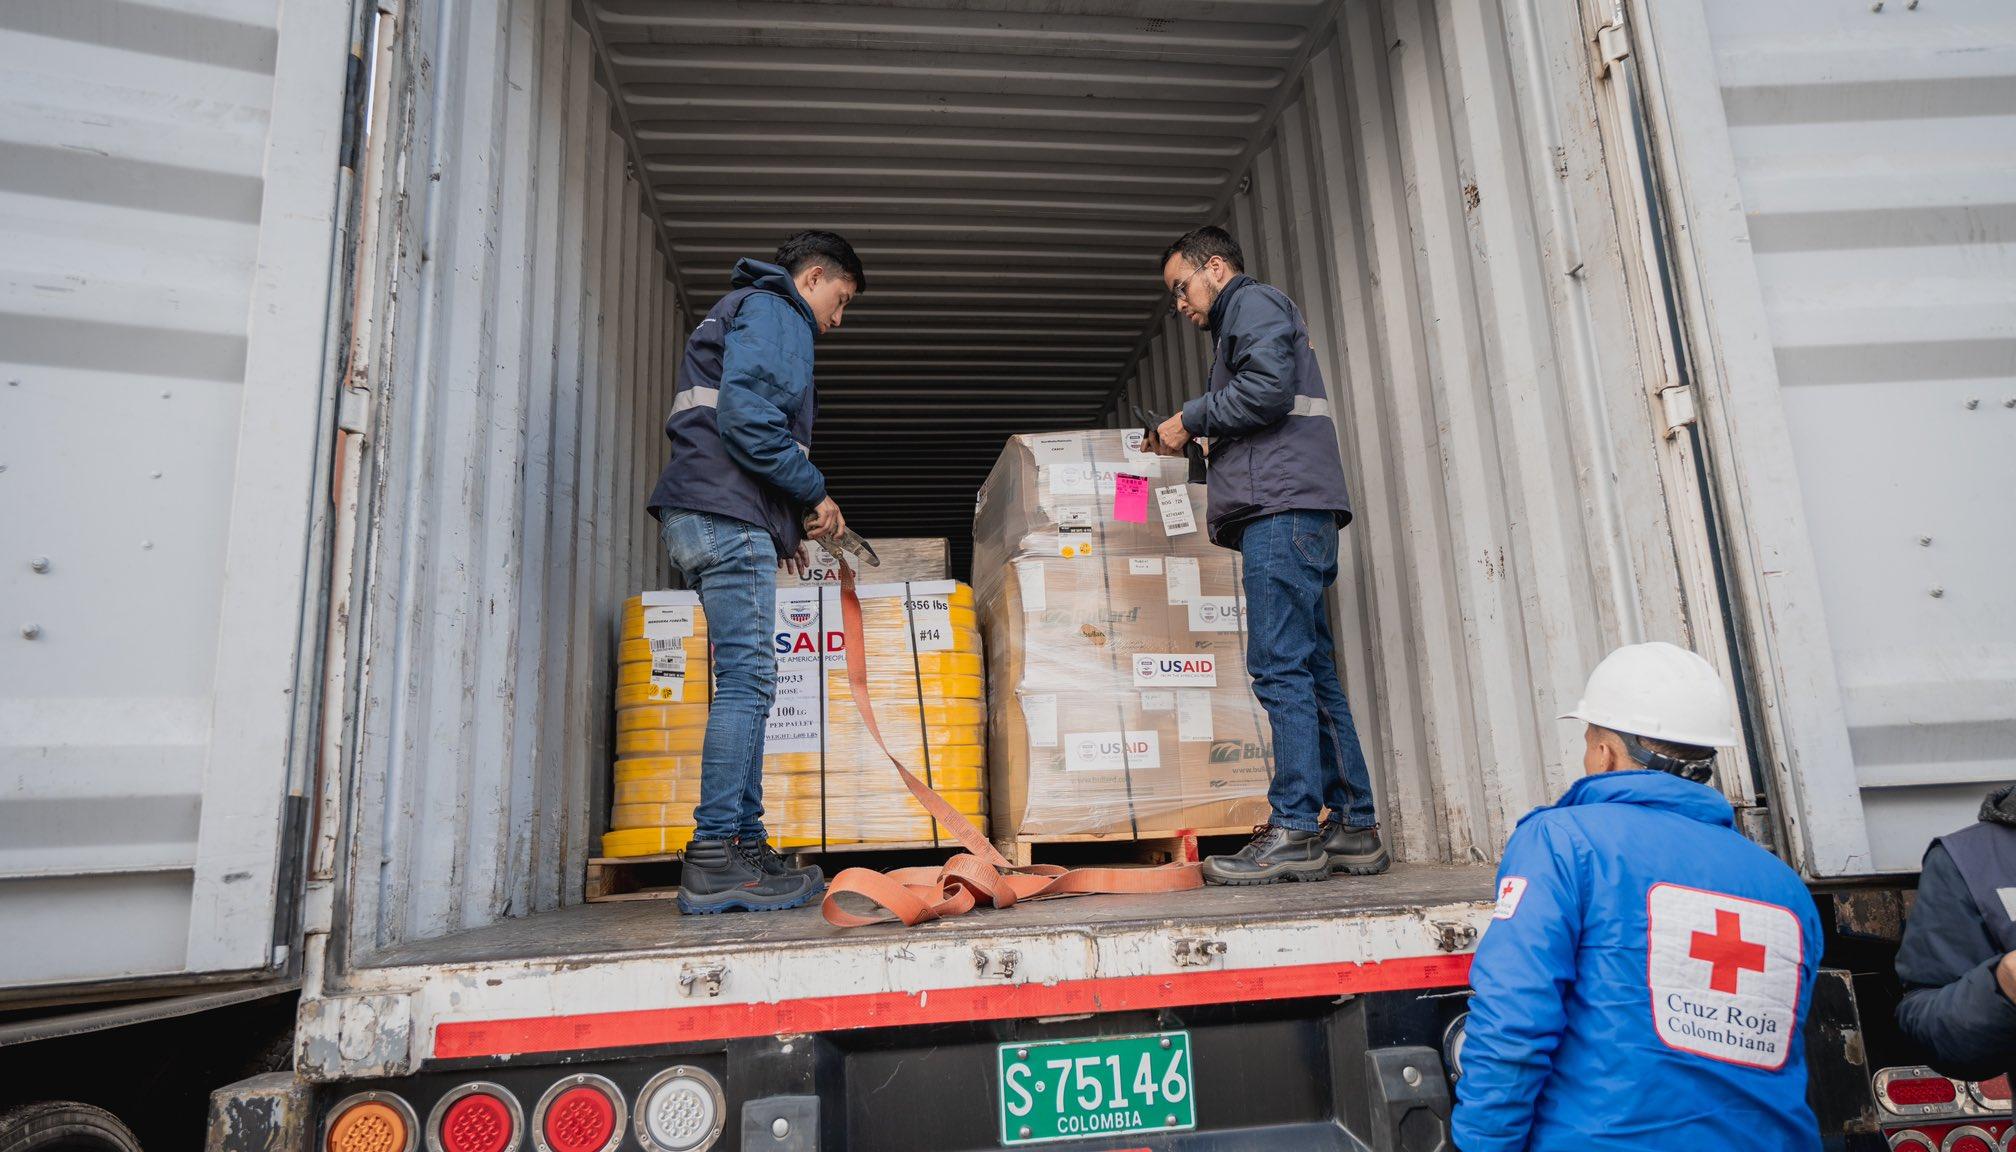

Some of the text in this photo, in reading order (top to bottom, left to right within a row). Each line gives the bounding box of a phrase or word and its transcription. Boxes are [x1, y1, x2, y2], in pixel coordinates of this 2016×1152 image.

[933, 600, 948, 611] lbs
[1221, 606, 1247, 617] USA
[920, 629, 940, 641] #14
[775, 631, 846, 654] SAD
[825, 654, 845, 662] PEOPL
[1160, 660, 1213, 673] USAID
[777, 706, 795, 717] 100
[1100, 741, 1149, 754] USAID
[1667, 993, 1777, 1035] Cruz Roja
[1668, 1017, 1776, 1053] Colombiana
[1057, 1110, 1143, 1134] COLOMBIA
